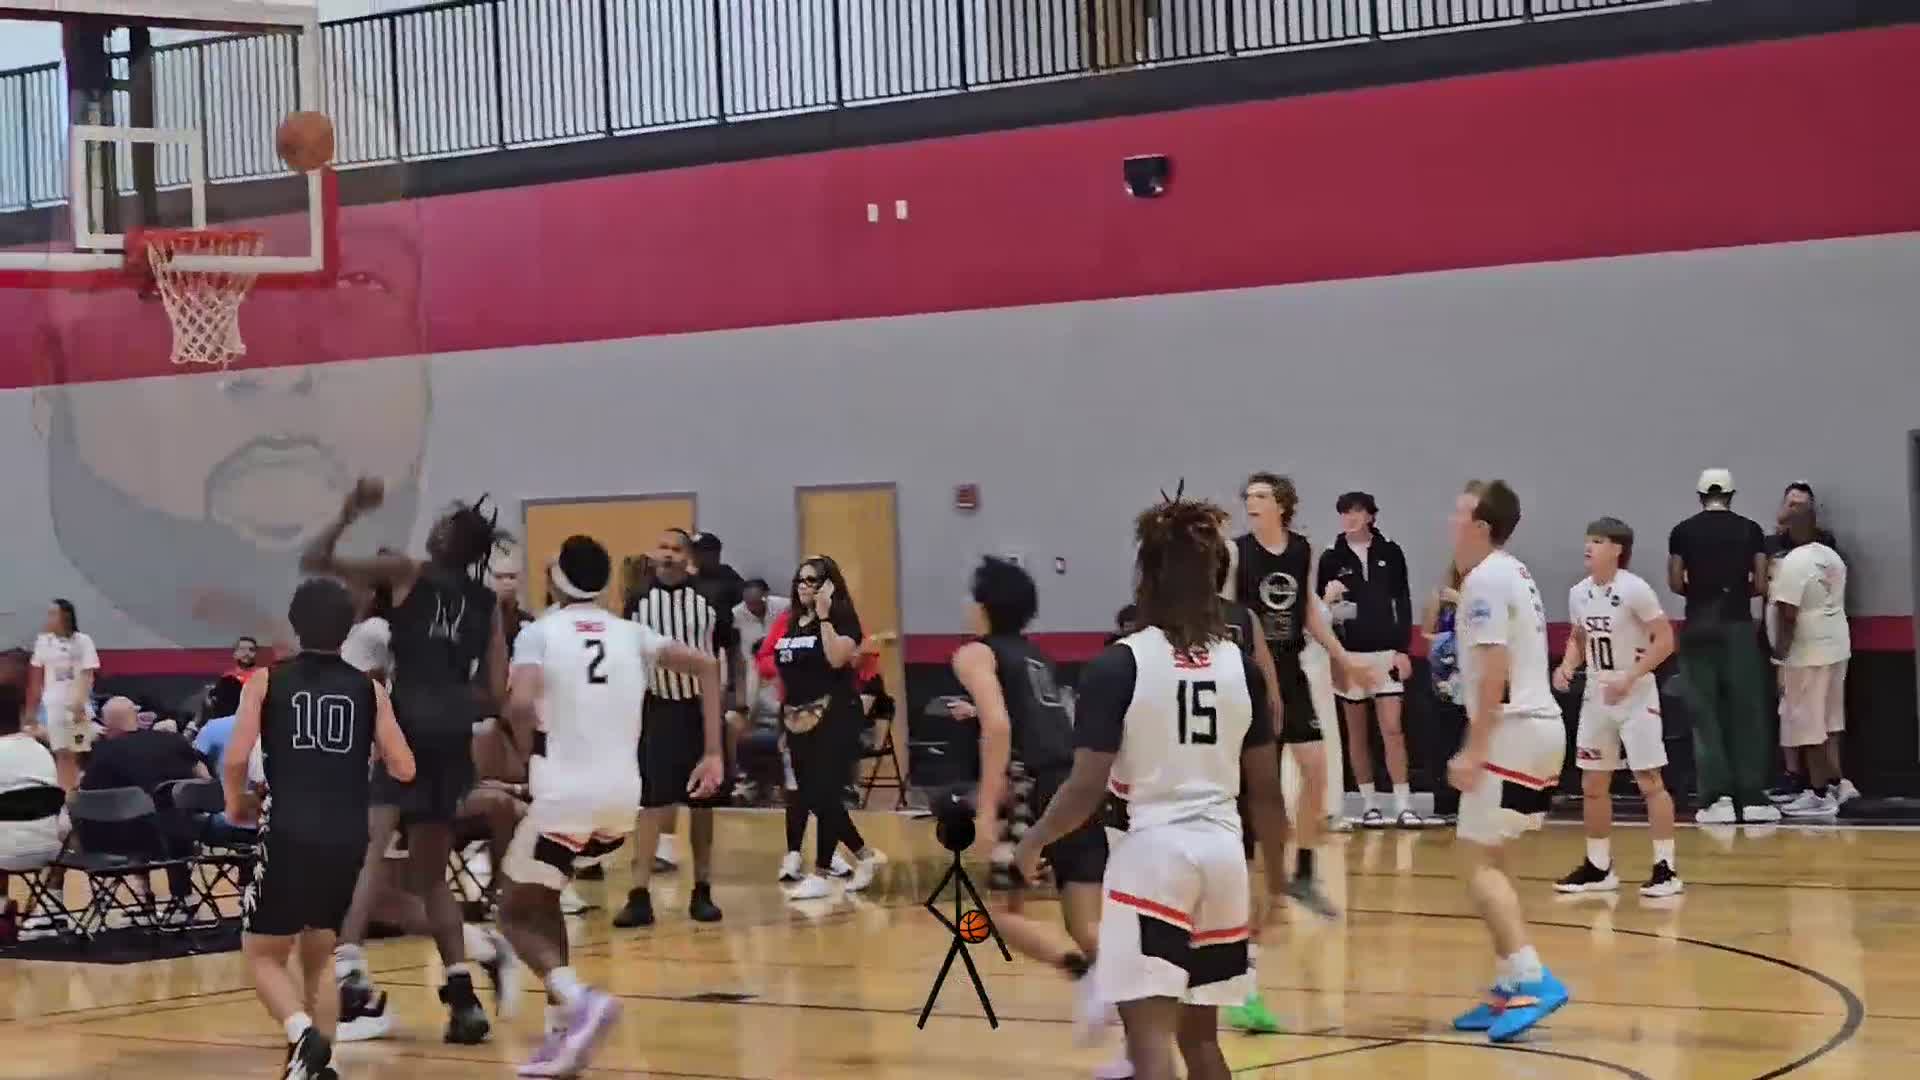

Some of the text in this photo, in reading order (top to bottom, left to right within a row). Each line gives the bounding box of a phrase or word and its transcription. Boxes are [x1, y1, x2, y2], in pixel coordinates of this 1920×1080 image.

[585, 639, 608, 684] 2
[1590, 637, 1614, 671] 10
[292, 691, 354, 754] 10
[1177, 680, 1216, 744] 15
